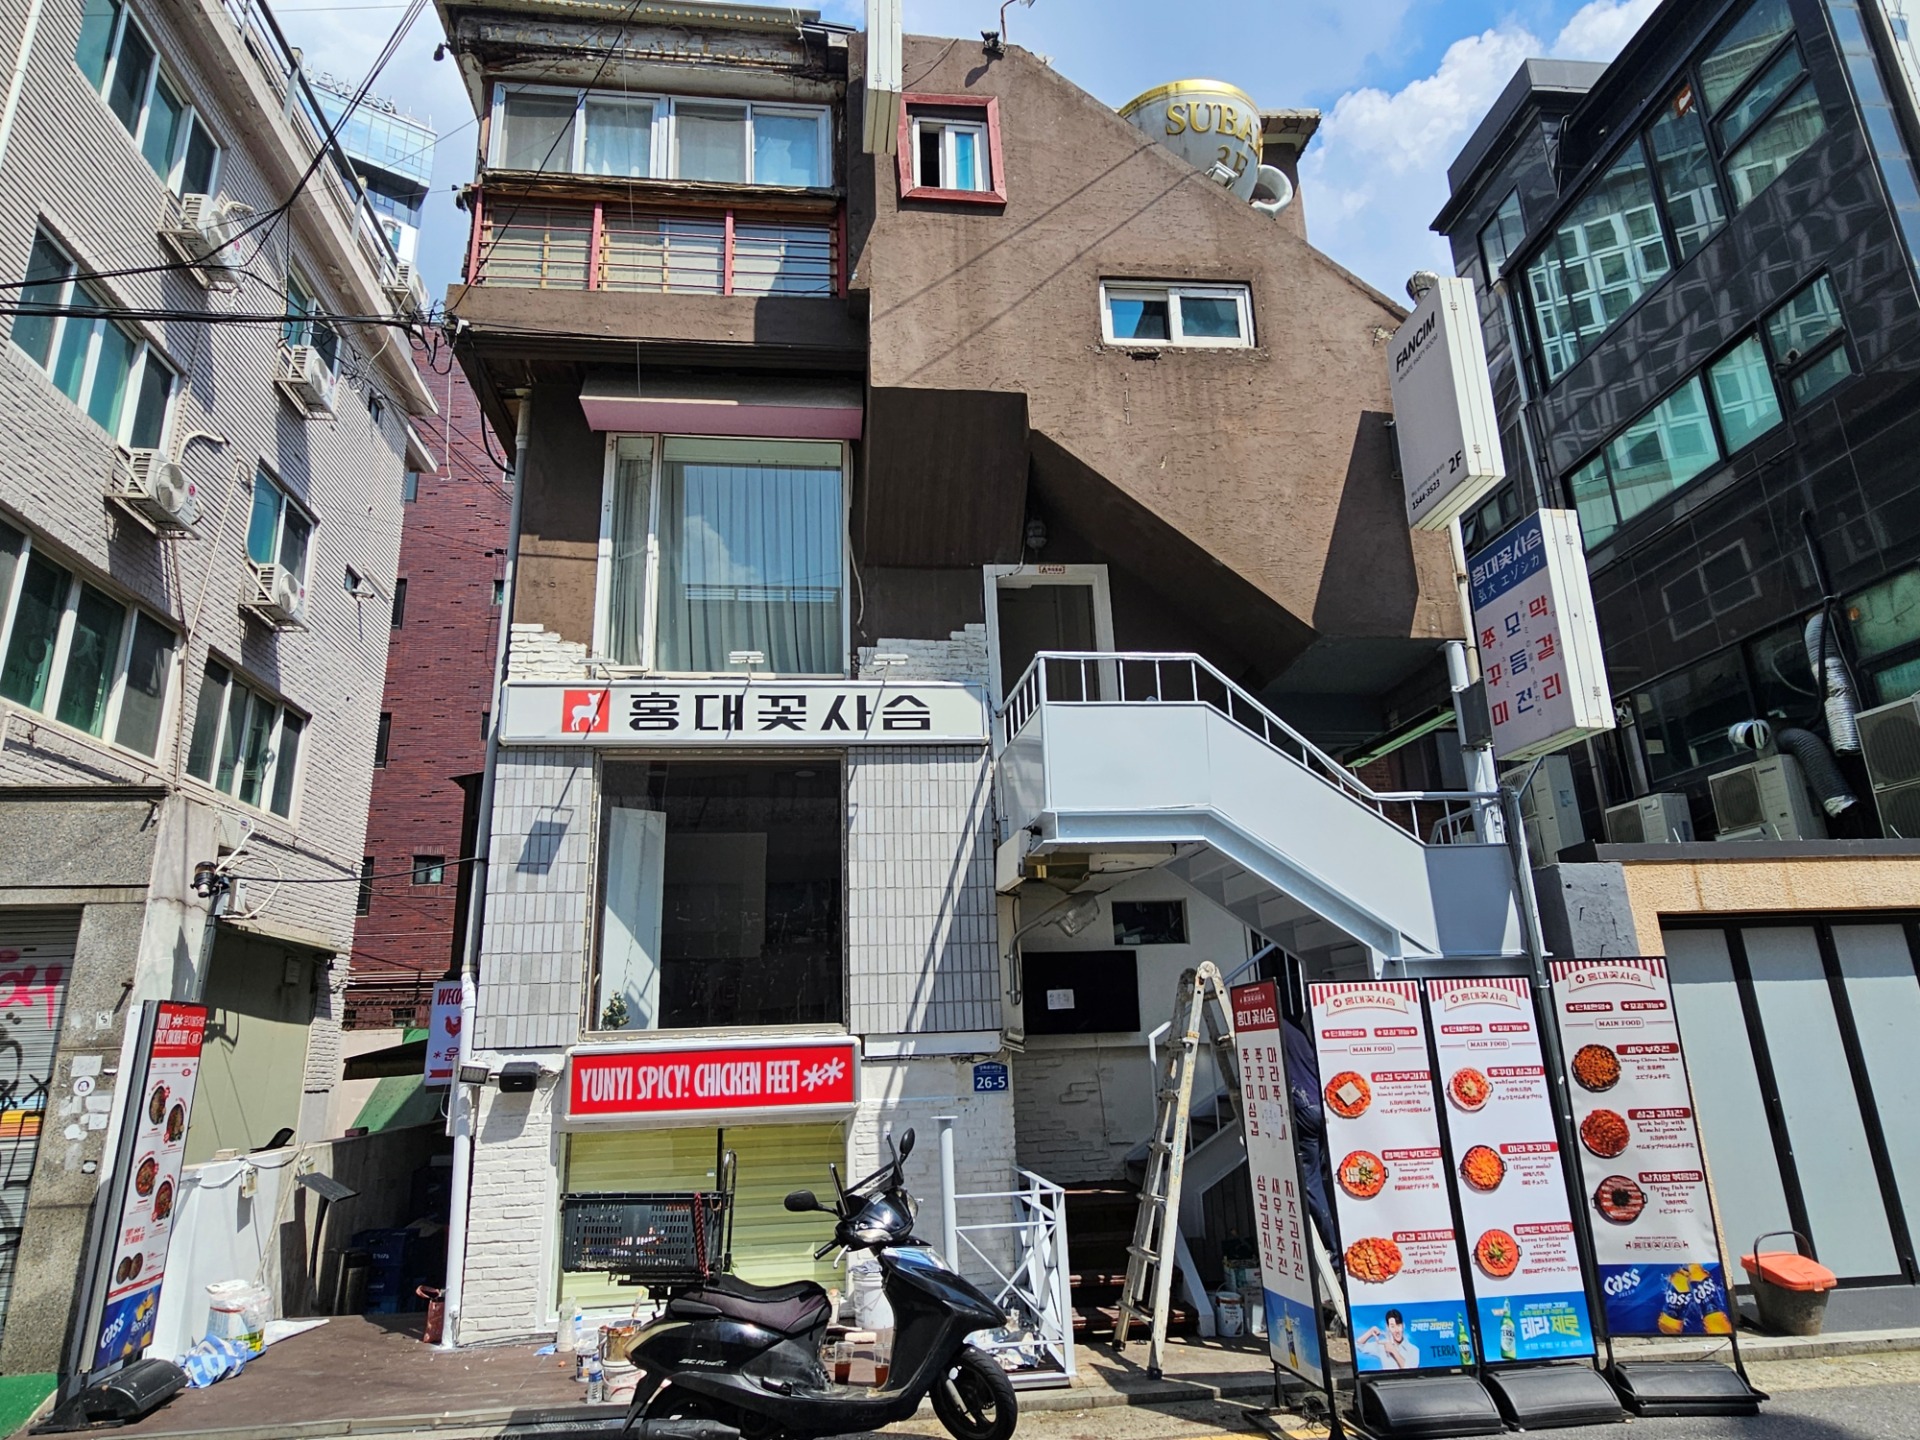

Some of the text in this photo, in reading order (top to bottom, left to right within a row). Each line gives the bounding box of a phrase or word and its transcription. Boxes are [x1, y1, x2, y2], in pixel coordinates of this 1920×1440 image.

[1396, 311, 1435, 373] FANCIM
[1448, 449, 1462, 475] 2F
[1471, 528, 1542, 588] 홍대꽃사슴
[1528, 594, 1562, 700] 막걸리
[1481, 625, 1510, 726] 쭈꾸미
[1504, 611, 1534, 714] 모듬전
[629, 691, 931, 731] 홍대꽃사슴
[1587, 970, 1641, 982] 홍대꽃사슴
[1344, 995, 1396, 1006] 홍대꽃사슴
[1461, 991, 1508, 1002] 홍대꽃사슴
[1627, 1045, 1670, 1054] 새우 부추전
[580, 1060, 800, 1102] YUNYI SPICY! CHICKEN FEET
[976, 1076, 1006, 1089] 26-5
[1375, 1072, 1428, 1081] 삼겹 두부김치
[1636, 1109, 1684, 1119] 삼겹 김치전
[1507, 1143, 1551, 1153] 마라 쭈꾸미
[1642, 1174, 1671, 1182] 날치알
[1256, 1174, 1273, 1270] 삼겹김치전
[1271, 1176, 1288, 1276] 새우부추전
[1284, 1178, 1304, 1282] 치즈김치전
[1396, 1232, 1415, 1241] 삼겹
[1604, 1268, 1641, 1295] Cass
[1520, 1314, 1581, 1340] 테라 제로
[1431, 1345, 1458, 1358] TERRA
